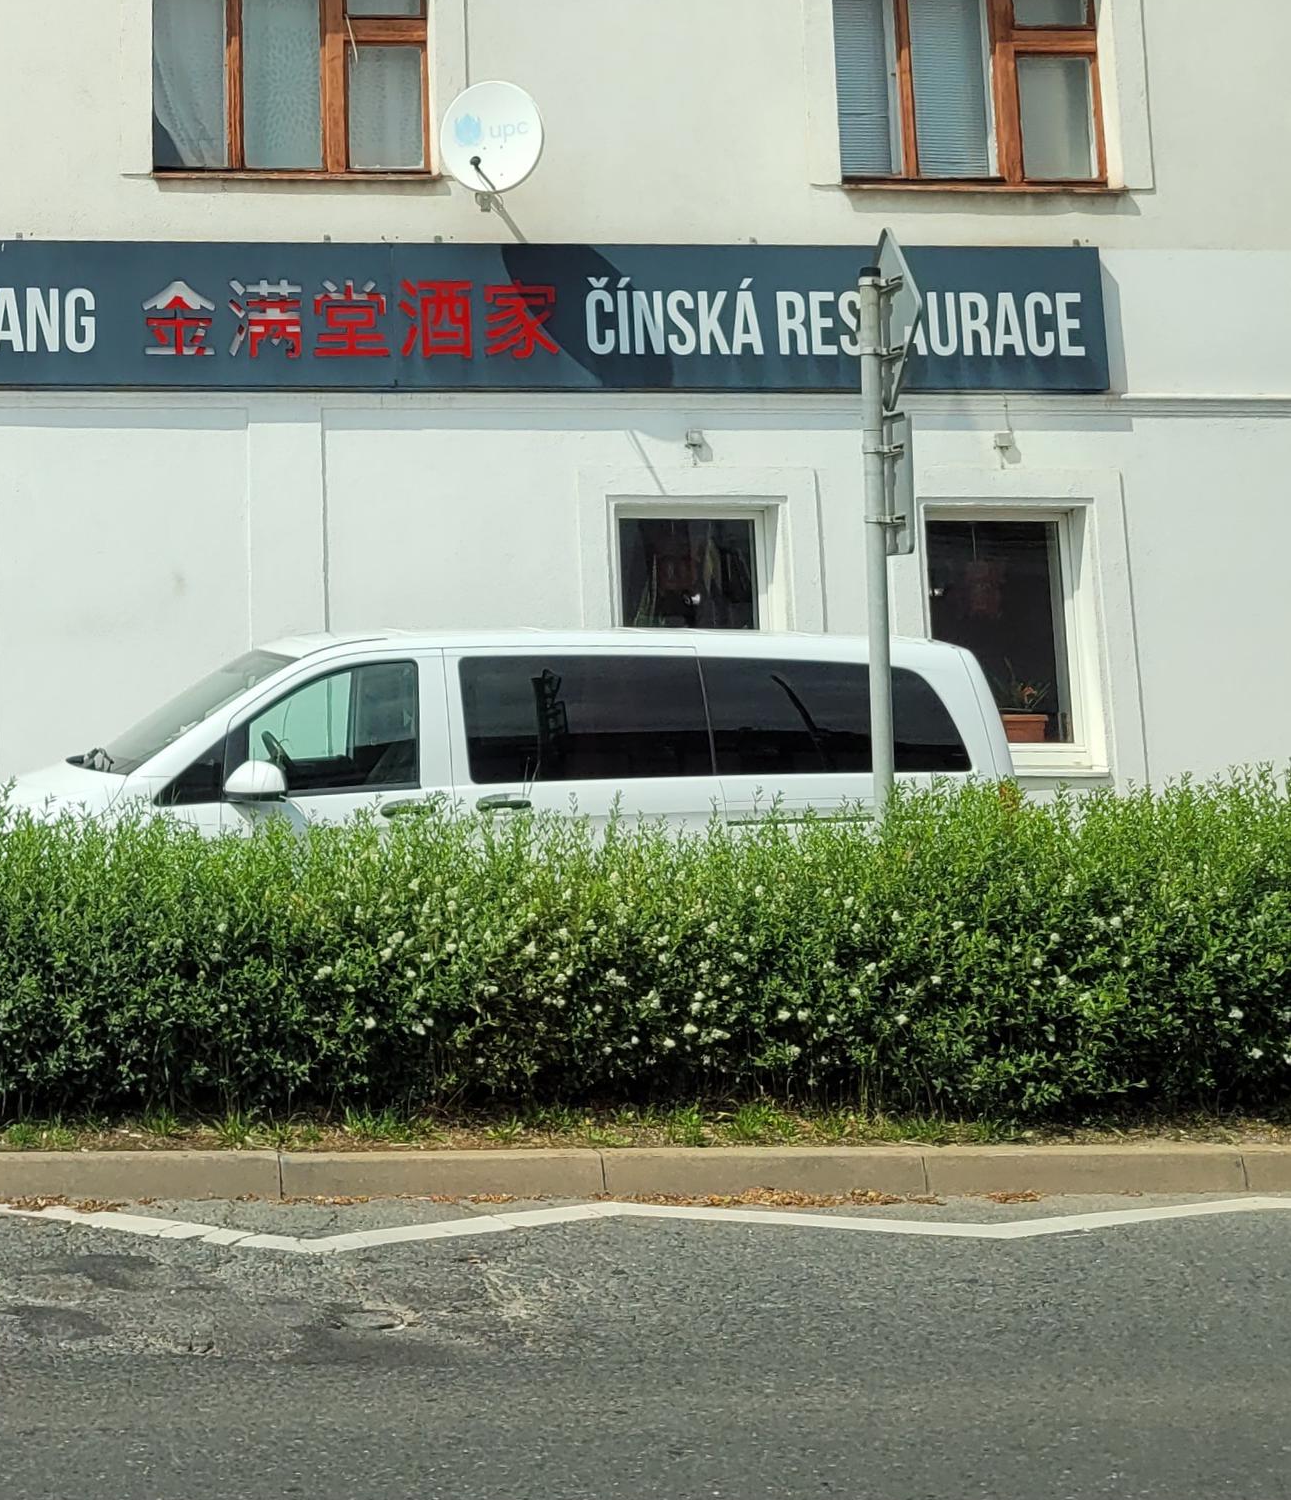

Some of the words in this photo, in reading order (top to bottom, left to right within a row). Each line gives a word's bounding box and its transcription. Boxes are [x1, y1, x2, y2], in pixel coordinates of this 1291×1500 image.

[489, 121, 529, 143] upc
[142, 278, 561, 360] 金满堂酒家
[584, 276, 765, 356] ČÍNSKÁ
[775, 290, 1086, 357] RESURACE
